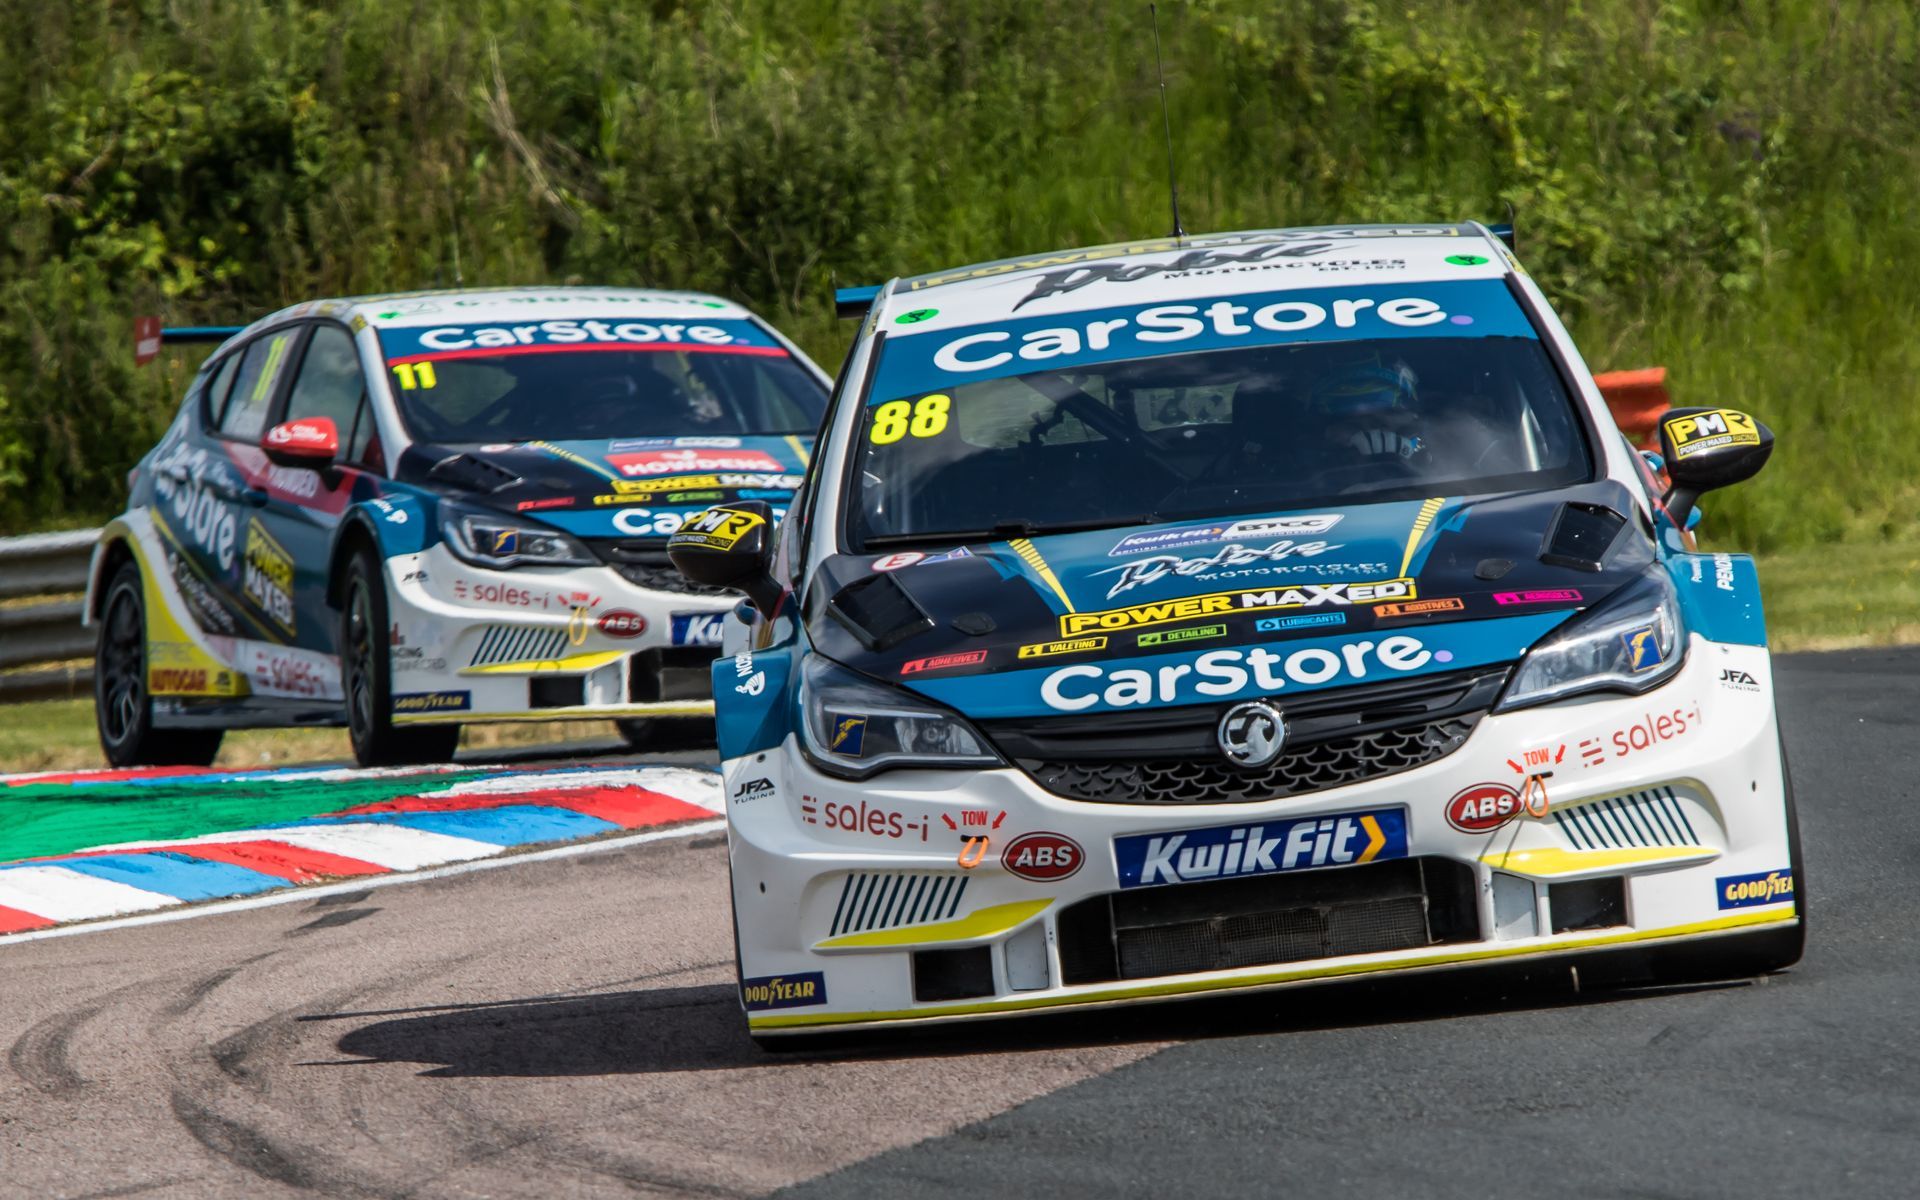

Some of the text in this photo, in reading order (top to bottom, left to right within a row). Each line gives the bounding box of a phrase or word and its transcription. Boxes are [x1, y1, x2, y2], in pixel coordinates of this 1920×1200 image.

[1163, 259, 1407, 280] MOTORCYCLES
[392, 361, 438, 391] 11
[870, 394, 951, 445] 88
[1670, 412, 1752, 444] PMR
[1679, 439, 1707, 456] POWER
[1707, 435, 1733, 447] MAXED
[622, 456, 777, 476] HOWDENS
[620, 473, 803, 494] POWER MAXE
[680, 510, 753, 535] PMR
[1237, 519, 1323, 532] BTCC
[473, 582, 550, 609] sales-i
[1403, 599, 1456, 613] ADDITIVES
[1069, 583, 1407, 633] POWER MAXED
[603, 617, 642, 630] ABS
[1281, 613, 1343, 629] LUBRICANTS
[1167, 625, 1218, 641] DETAILING
[1049, 638, 1096, 653] VALETING
[151, 669, 207, 692] AUTOCAR
[1719, 668, 1759, 686] JFA
[1720, 682, 1761, 693] TUNING
[1611, 699, 1703, 757] sales-i
[1523, 747, 1550, 768] TOW
[734, 777, 776, 798] JFA
[734, 789, 776, 805] TUNING
[960, 810, 989, 827] TOW
[1458, 794, 1515, 823] ABS
[824, 799, 930, 842] sales-i
[1014, 846, 1074, 868] ABS
[1725, 872, 1794, 901] GOODYEA
[744, 979, 816, 1004] OODYEAR
